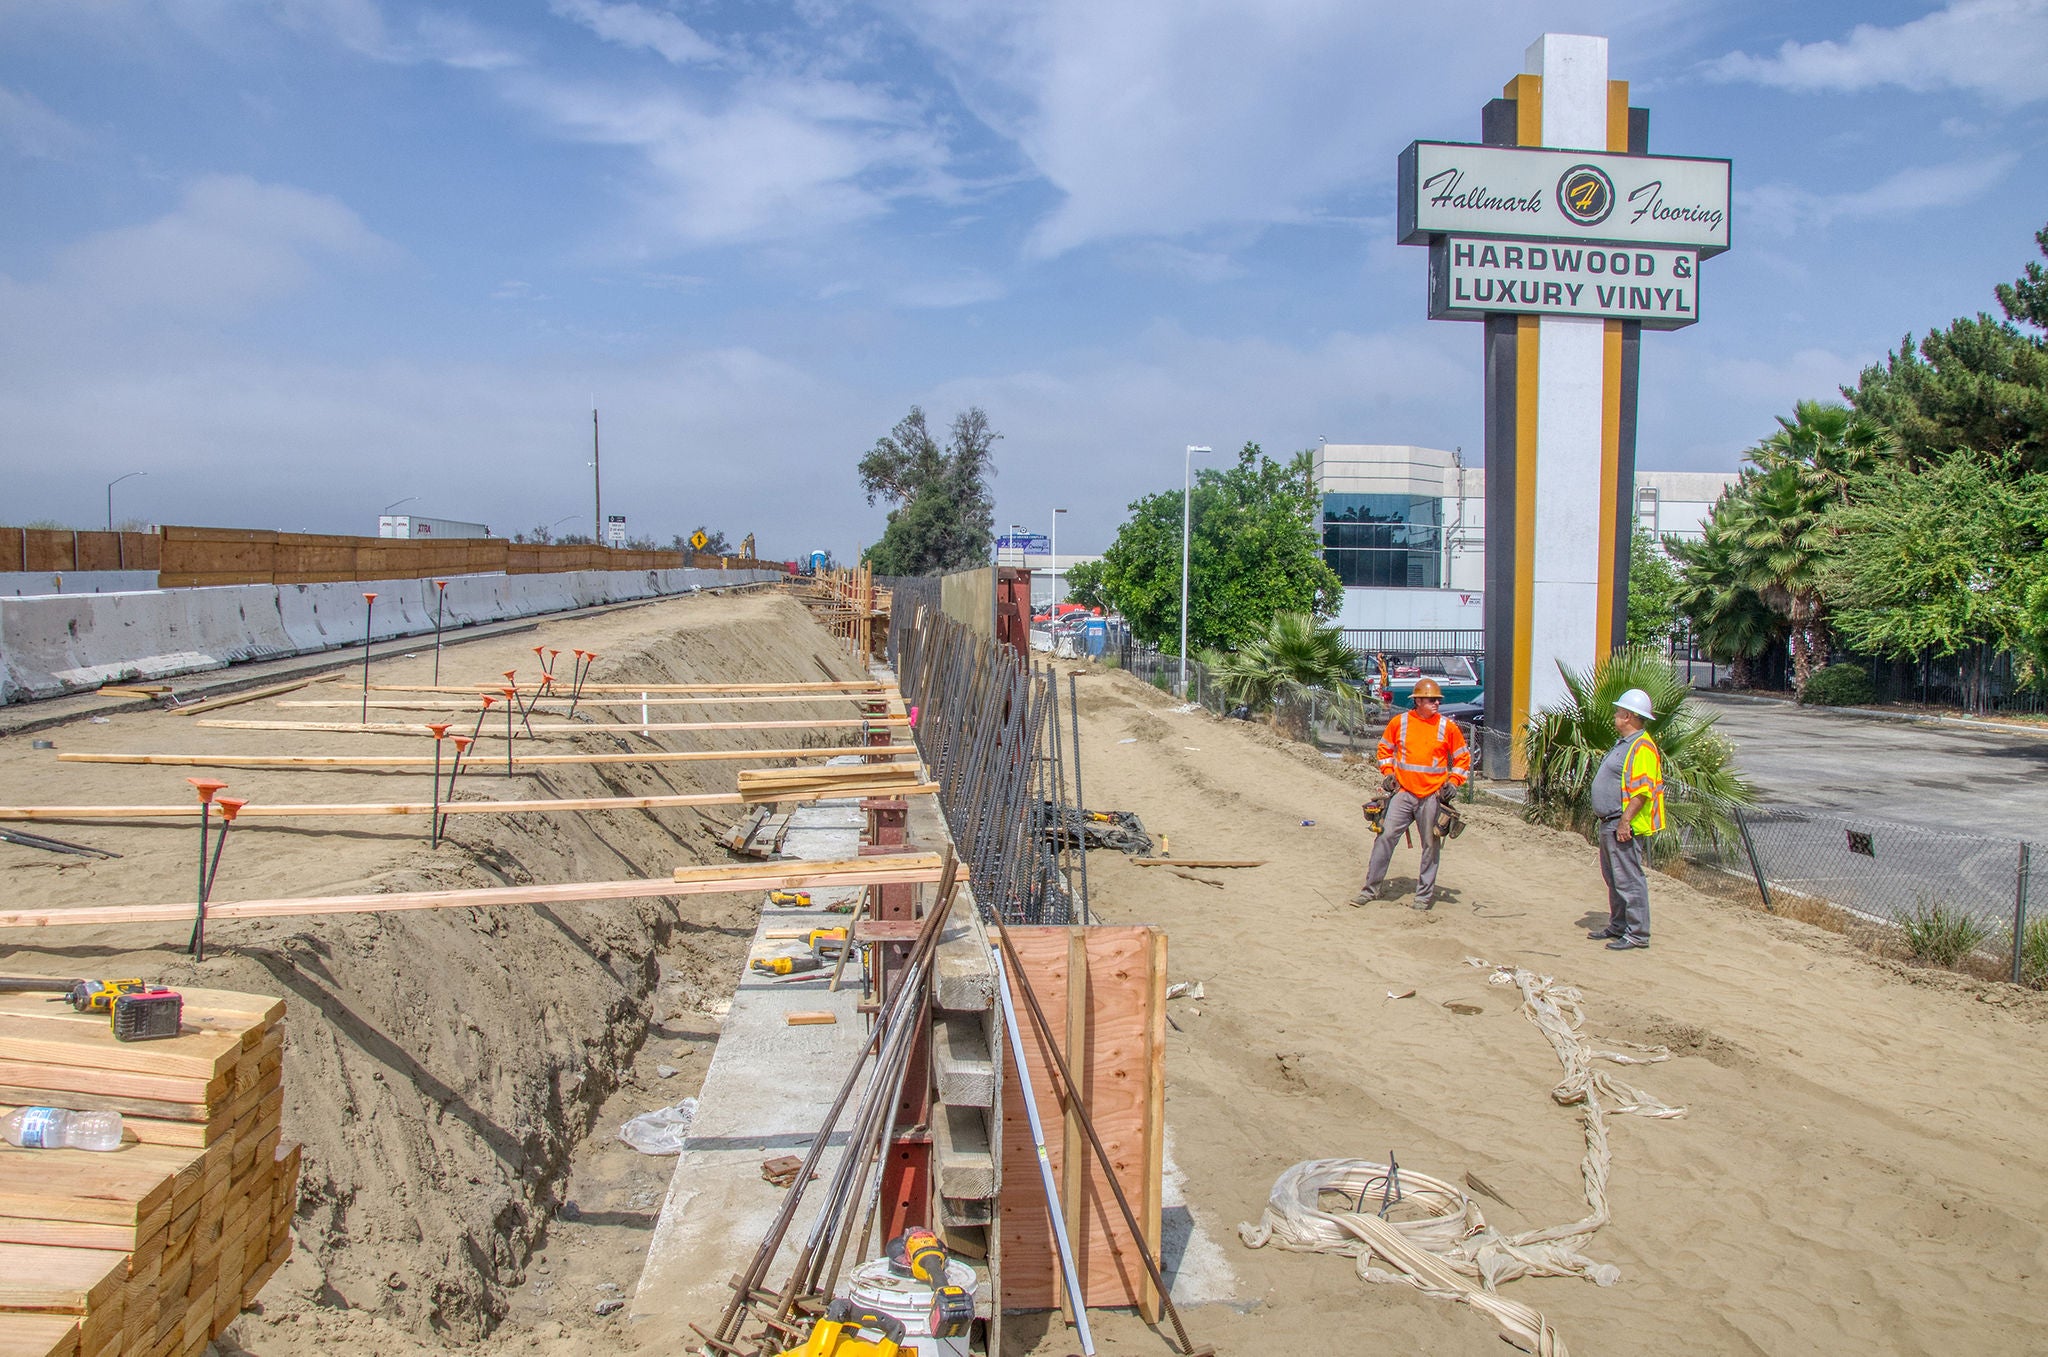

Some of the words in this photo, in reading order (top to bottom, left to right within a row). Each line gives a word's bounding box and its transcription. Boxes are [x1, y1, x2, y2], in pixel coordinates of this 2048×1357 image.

[1423, 168, 1542, 213] Hallmark
[1628, 180, 1723, 232] Flooring
[1454, 243, 1656, 277] HARDWOOD
[1672, 255, 1692, 279] &
[1455, 277, 1585, 307] LUXURY
[1596, 284, 1691, 313] VINYL
[417, 524, 431, 534] XTRA
